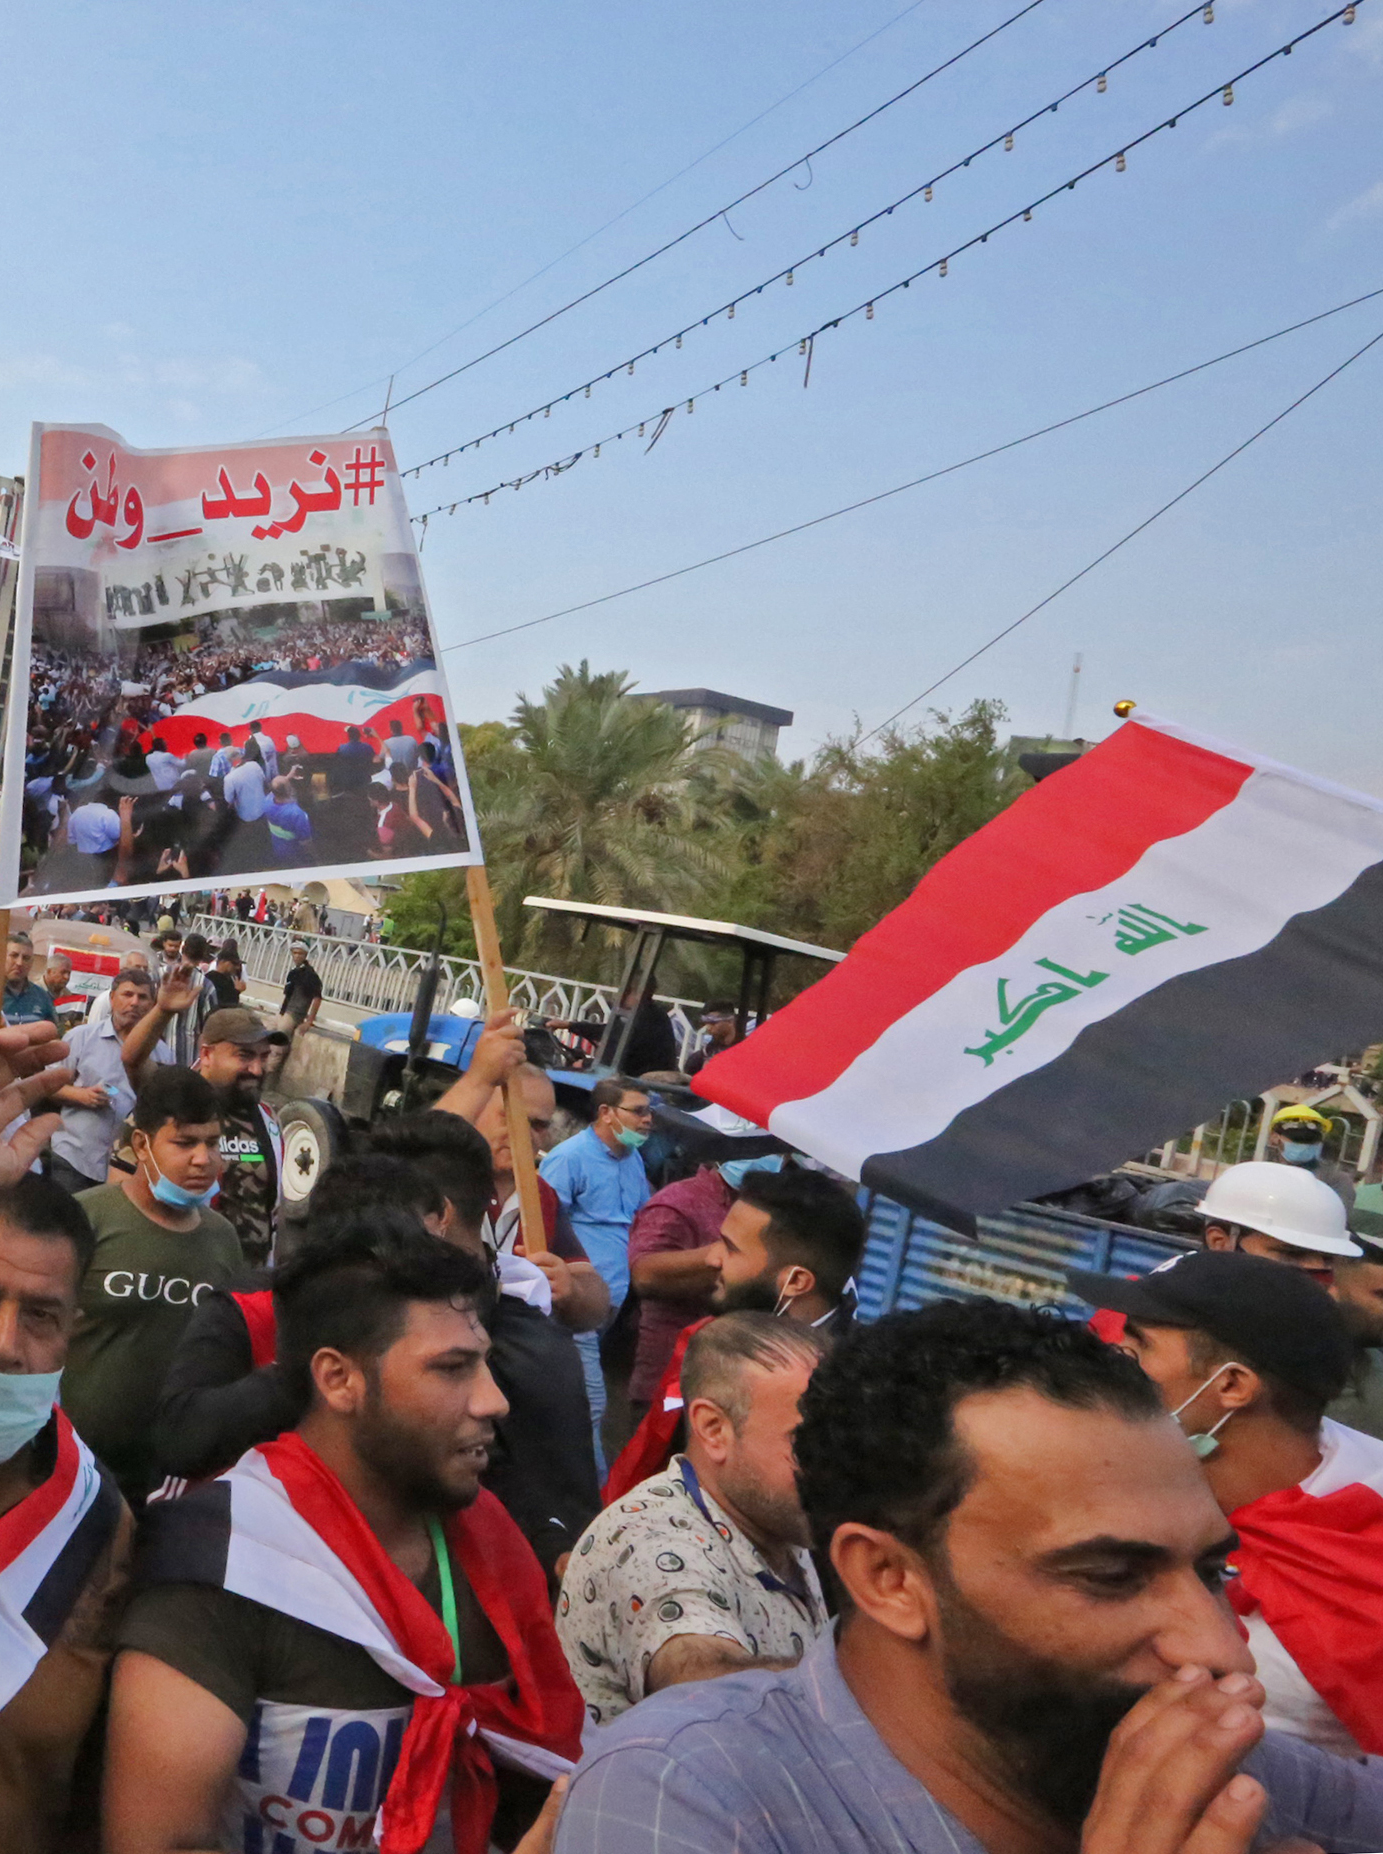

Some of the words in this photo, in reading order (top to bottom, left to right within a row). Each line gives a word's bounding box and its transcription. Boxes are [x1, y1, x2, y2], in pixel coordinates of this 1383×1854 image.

[65, 447, 385, 549] #نريد_وطن
[1086, 903, 1210, 956] الله
[219, 1135, 260, 1153] didas
[103, 1271, 214, 1307] GUCC
